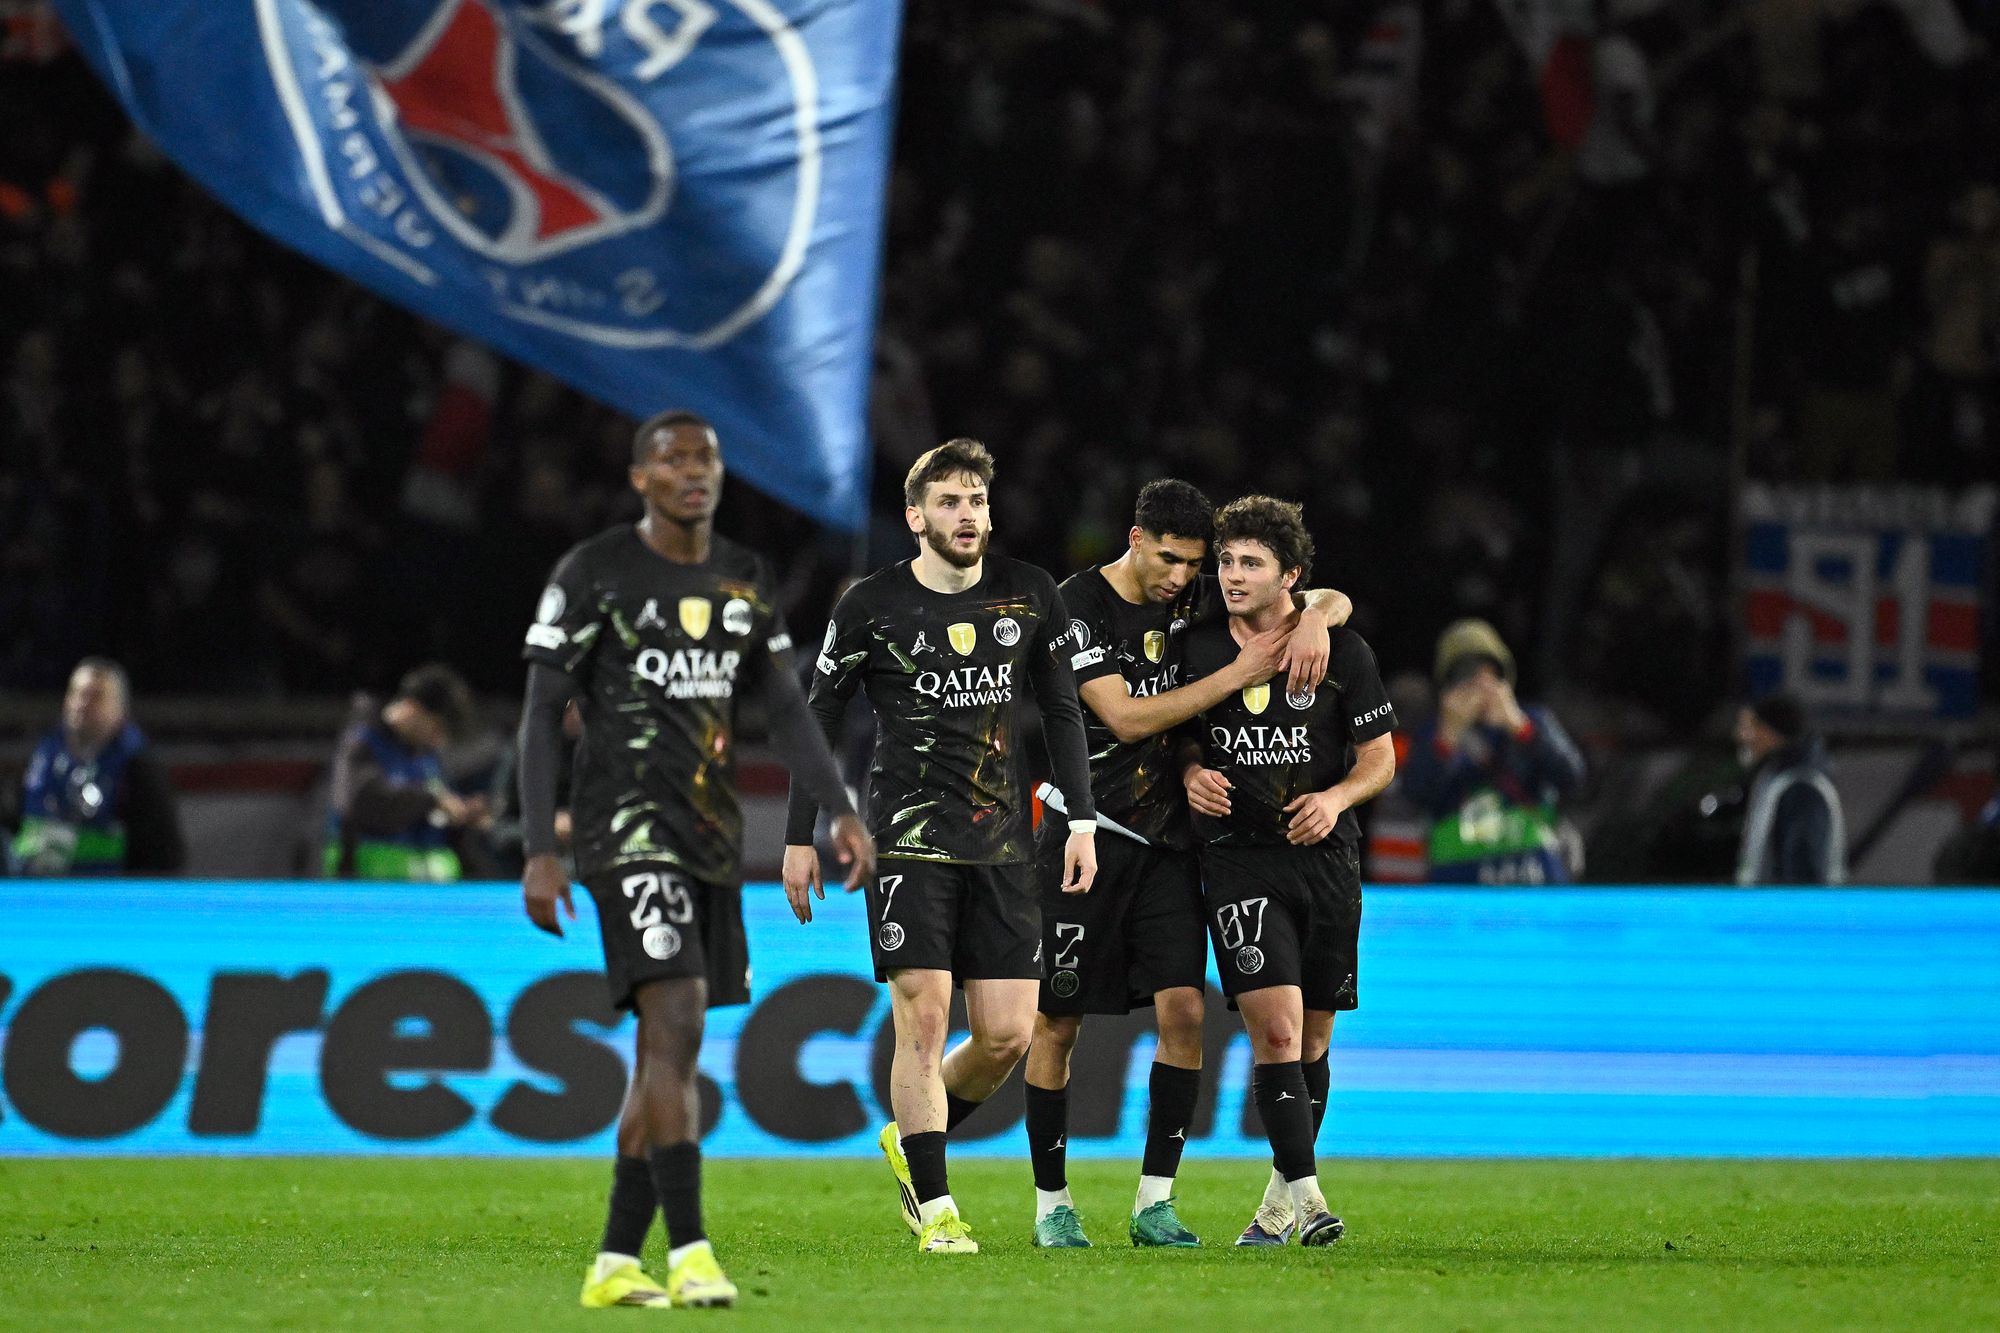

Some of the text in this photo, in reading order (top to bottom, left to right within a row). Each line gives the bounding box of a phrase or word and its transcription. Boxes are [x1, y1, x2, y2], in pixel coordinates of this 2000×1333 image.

[635, 648, 740, 686] QATAR
[915, 663, 1012, 699] QATAR
[942, 687, 1012, 709] AIRWAYS
[1210, 726, 1310, 754] QATAR
[1235, 748, 1312, 766] AIRWAYS
[621, 871, 694, 931] 25
[879, 874, 904, 922] 7
[1055, 921, 1085, 969] 2
